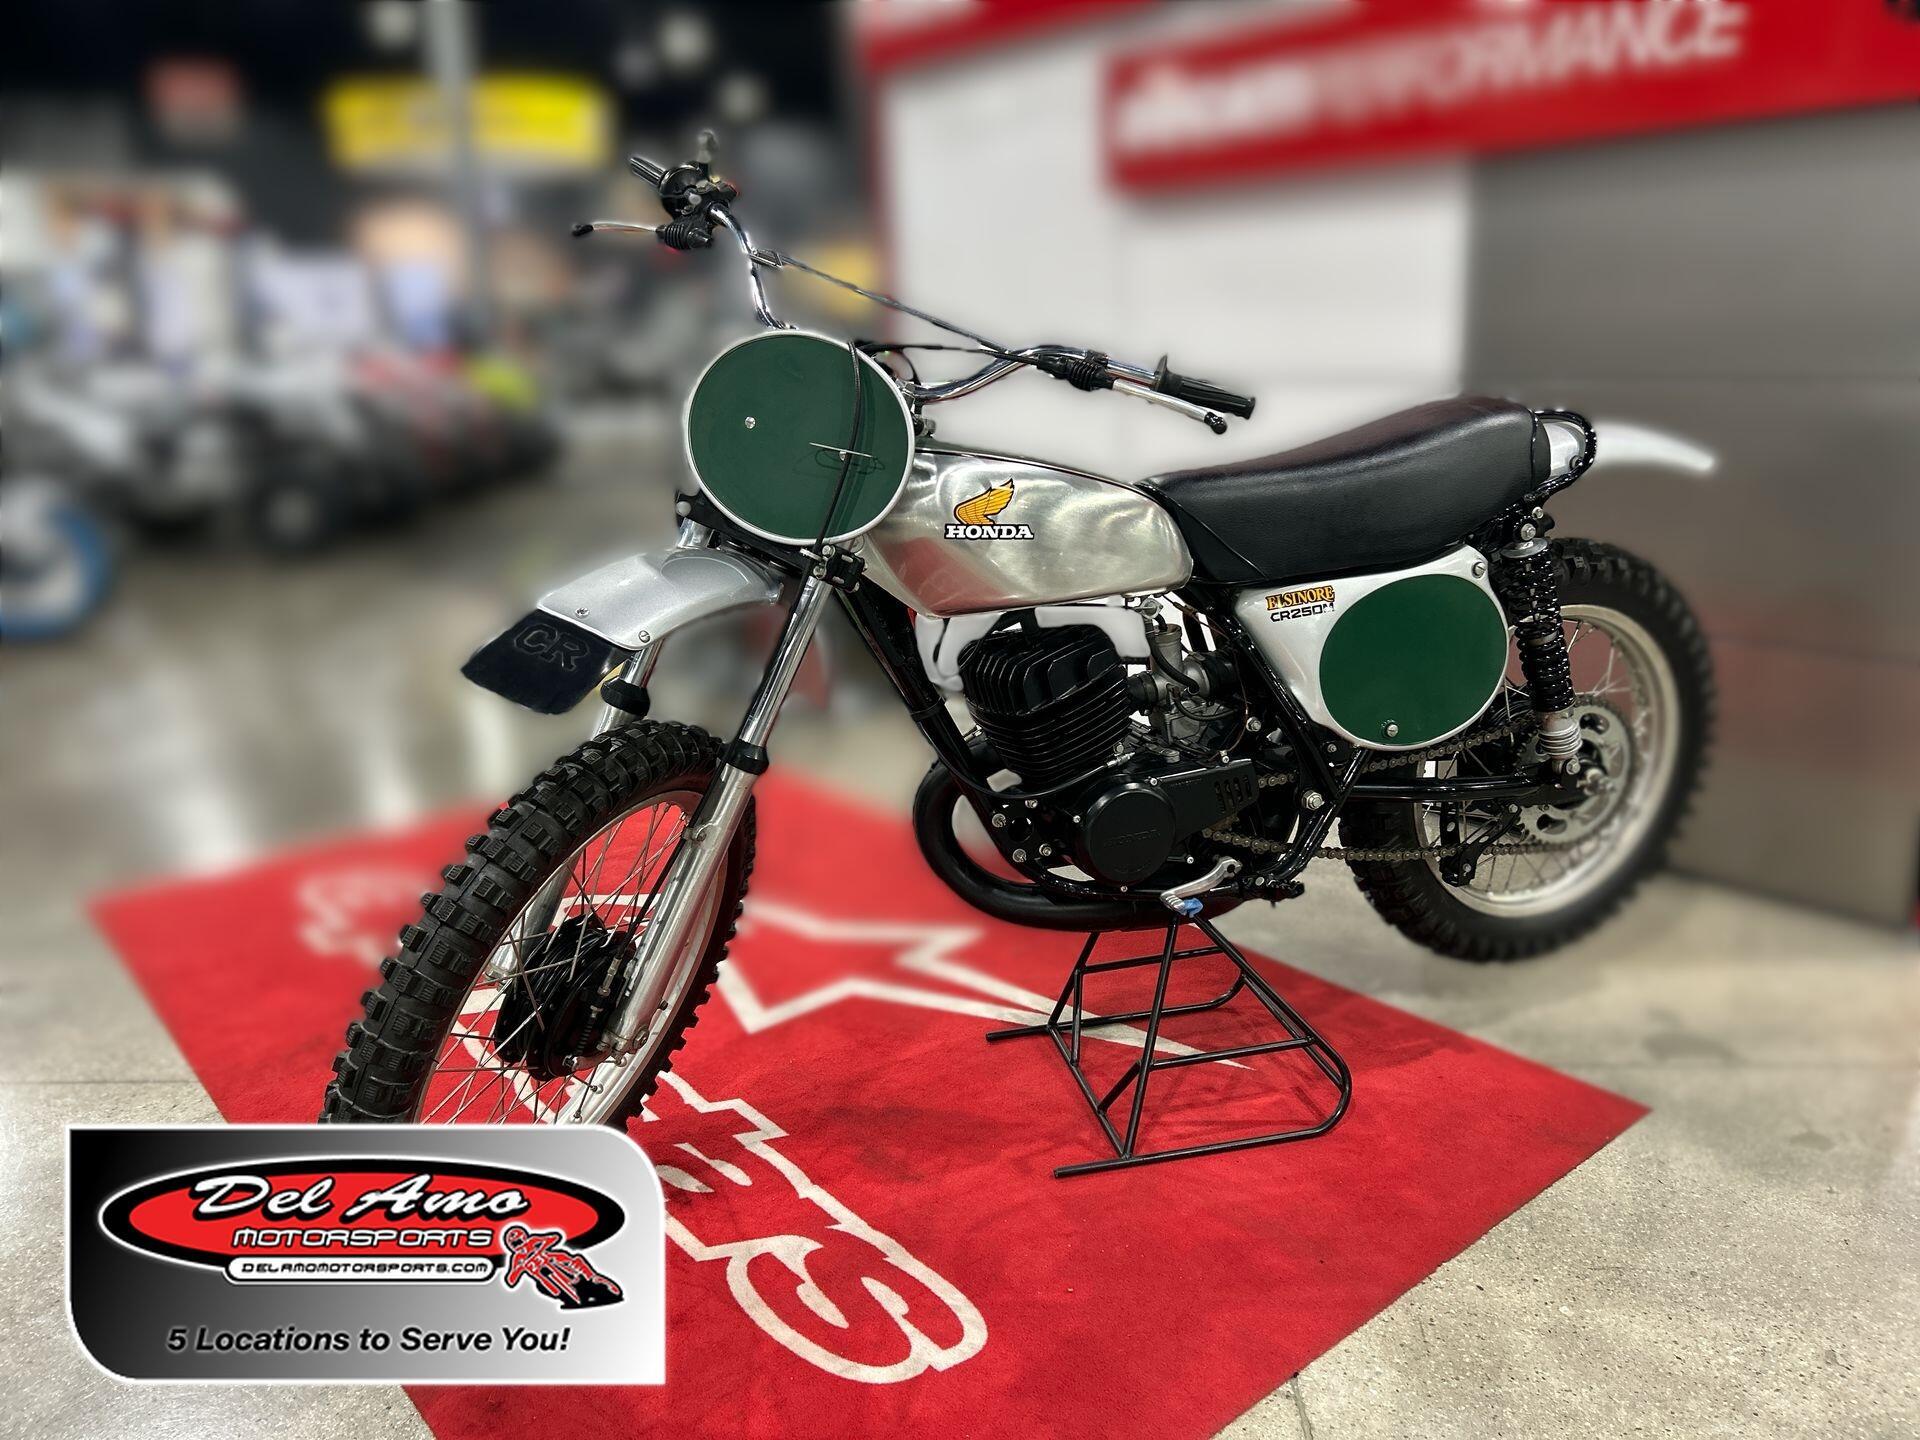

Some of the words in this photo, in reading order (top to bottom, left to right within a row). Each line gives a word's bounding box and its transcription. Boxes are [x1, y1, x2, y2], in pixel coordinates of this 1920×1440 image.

[945, 525, 1034, 539] HONDA
[1266, 585, 1335, 610] ELSINORE
[514, 623, 589, 671] CR
